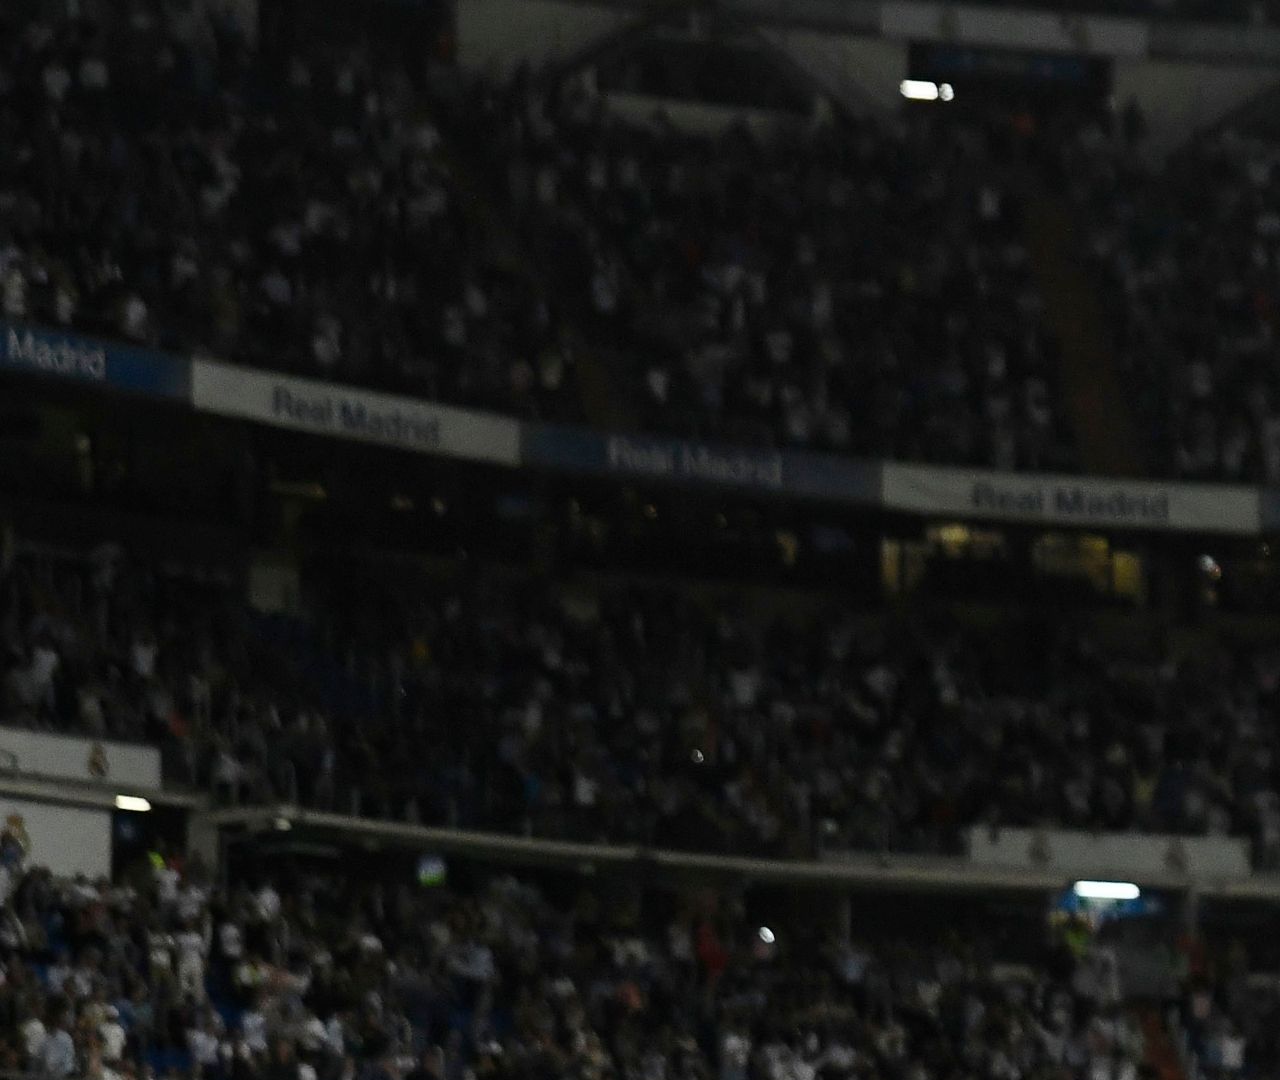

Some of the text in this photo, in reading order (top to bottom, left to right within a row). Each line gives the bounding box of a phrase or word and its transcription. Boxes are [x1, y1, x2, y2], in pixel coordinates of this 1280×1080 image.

[7, 326, 106, 382] Madrid
[272, 385, 441, 445] Real Madrid
[972, 482, 1169, 522] Real Madrid
